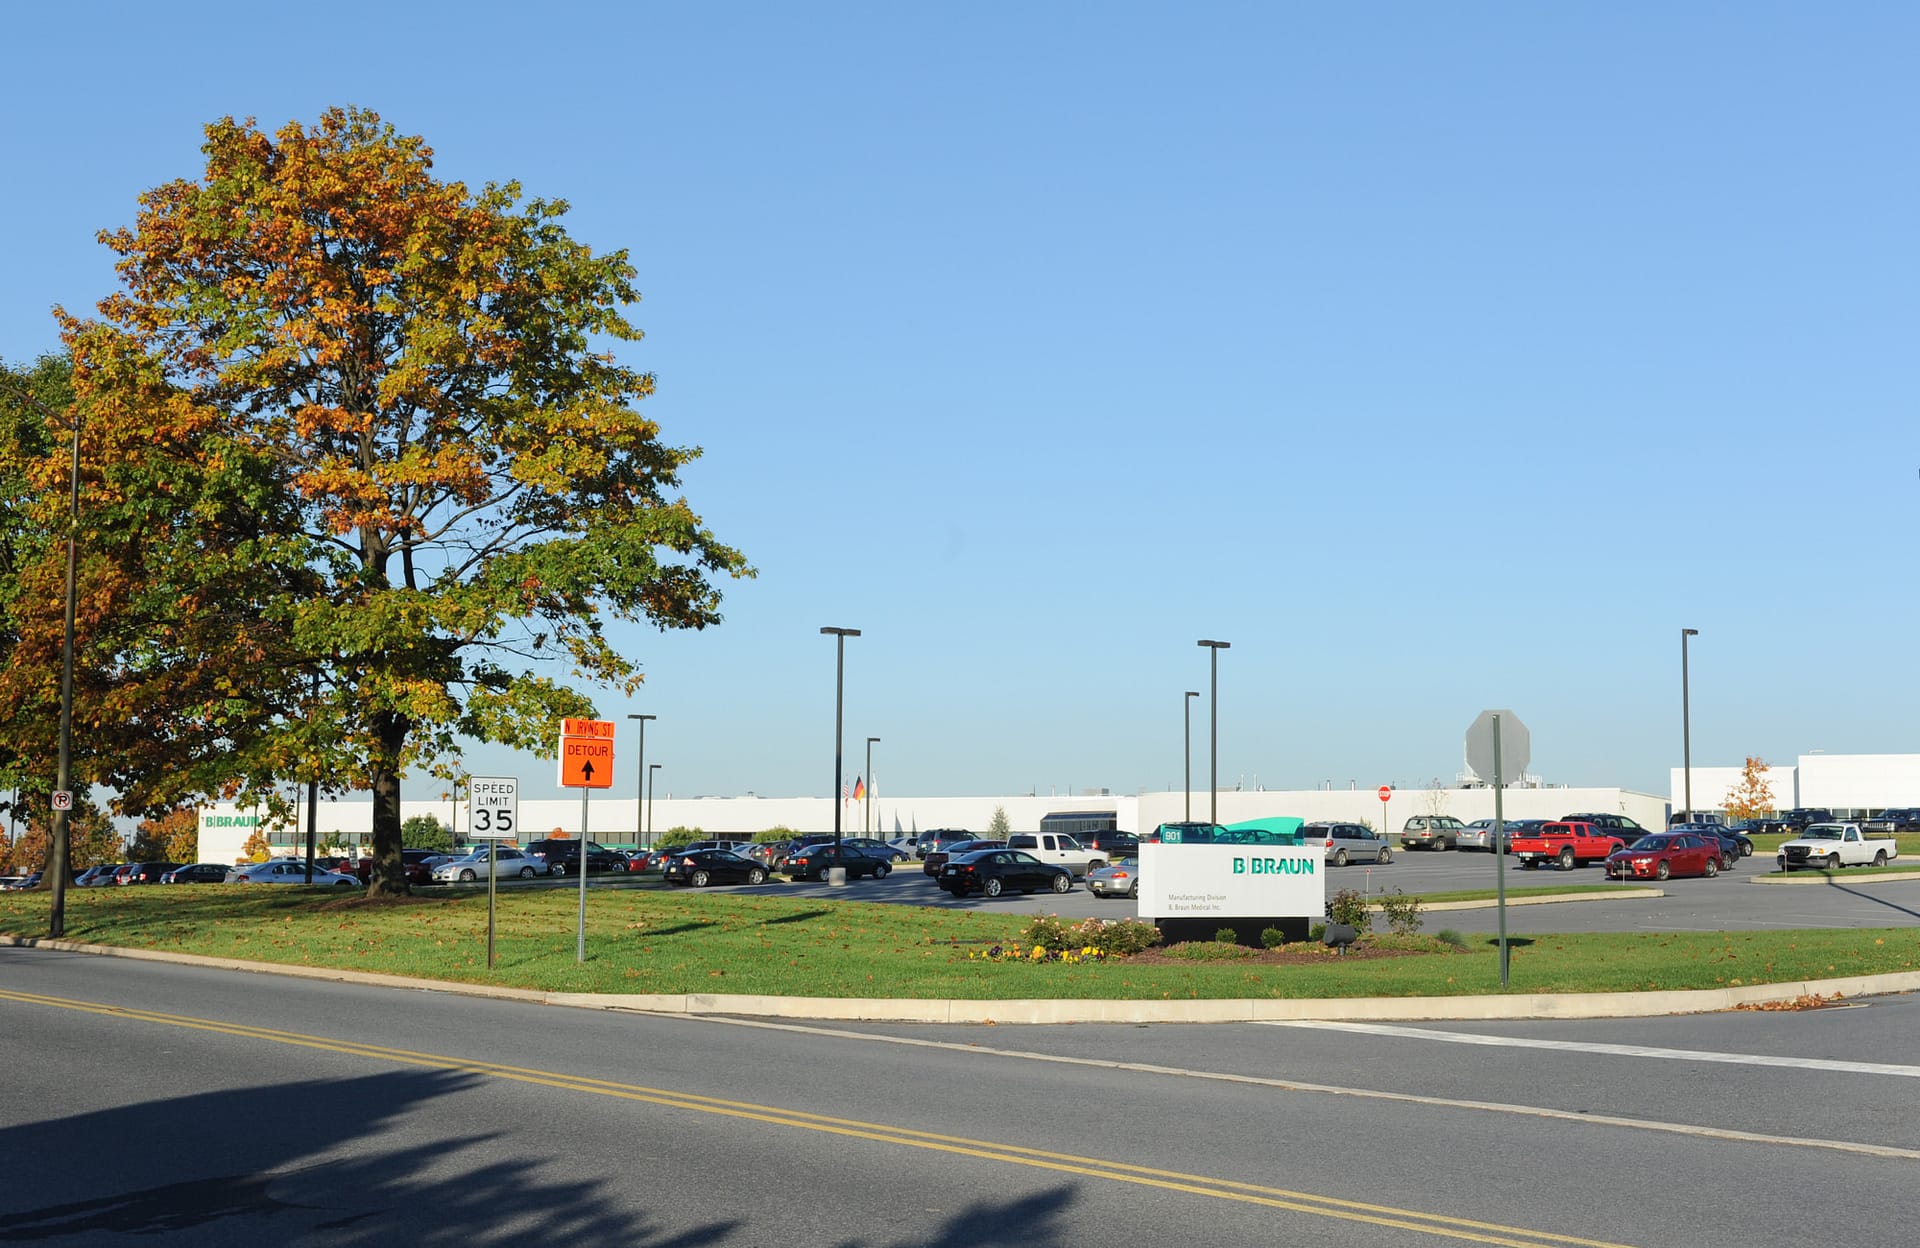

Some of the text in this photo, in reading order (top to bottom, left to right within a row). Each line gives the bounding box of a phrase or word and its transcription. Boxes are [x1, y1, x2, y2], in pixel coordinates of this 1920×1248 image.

[564, 720, 611, 737] N IRVING ST
[567, 744, 609, 757] DETOUR
[474, 784, 514, 794] SPEED
[478, 797, 509, 807] LIMIT
[474, 809, 513, 831] 35
